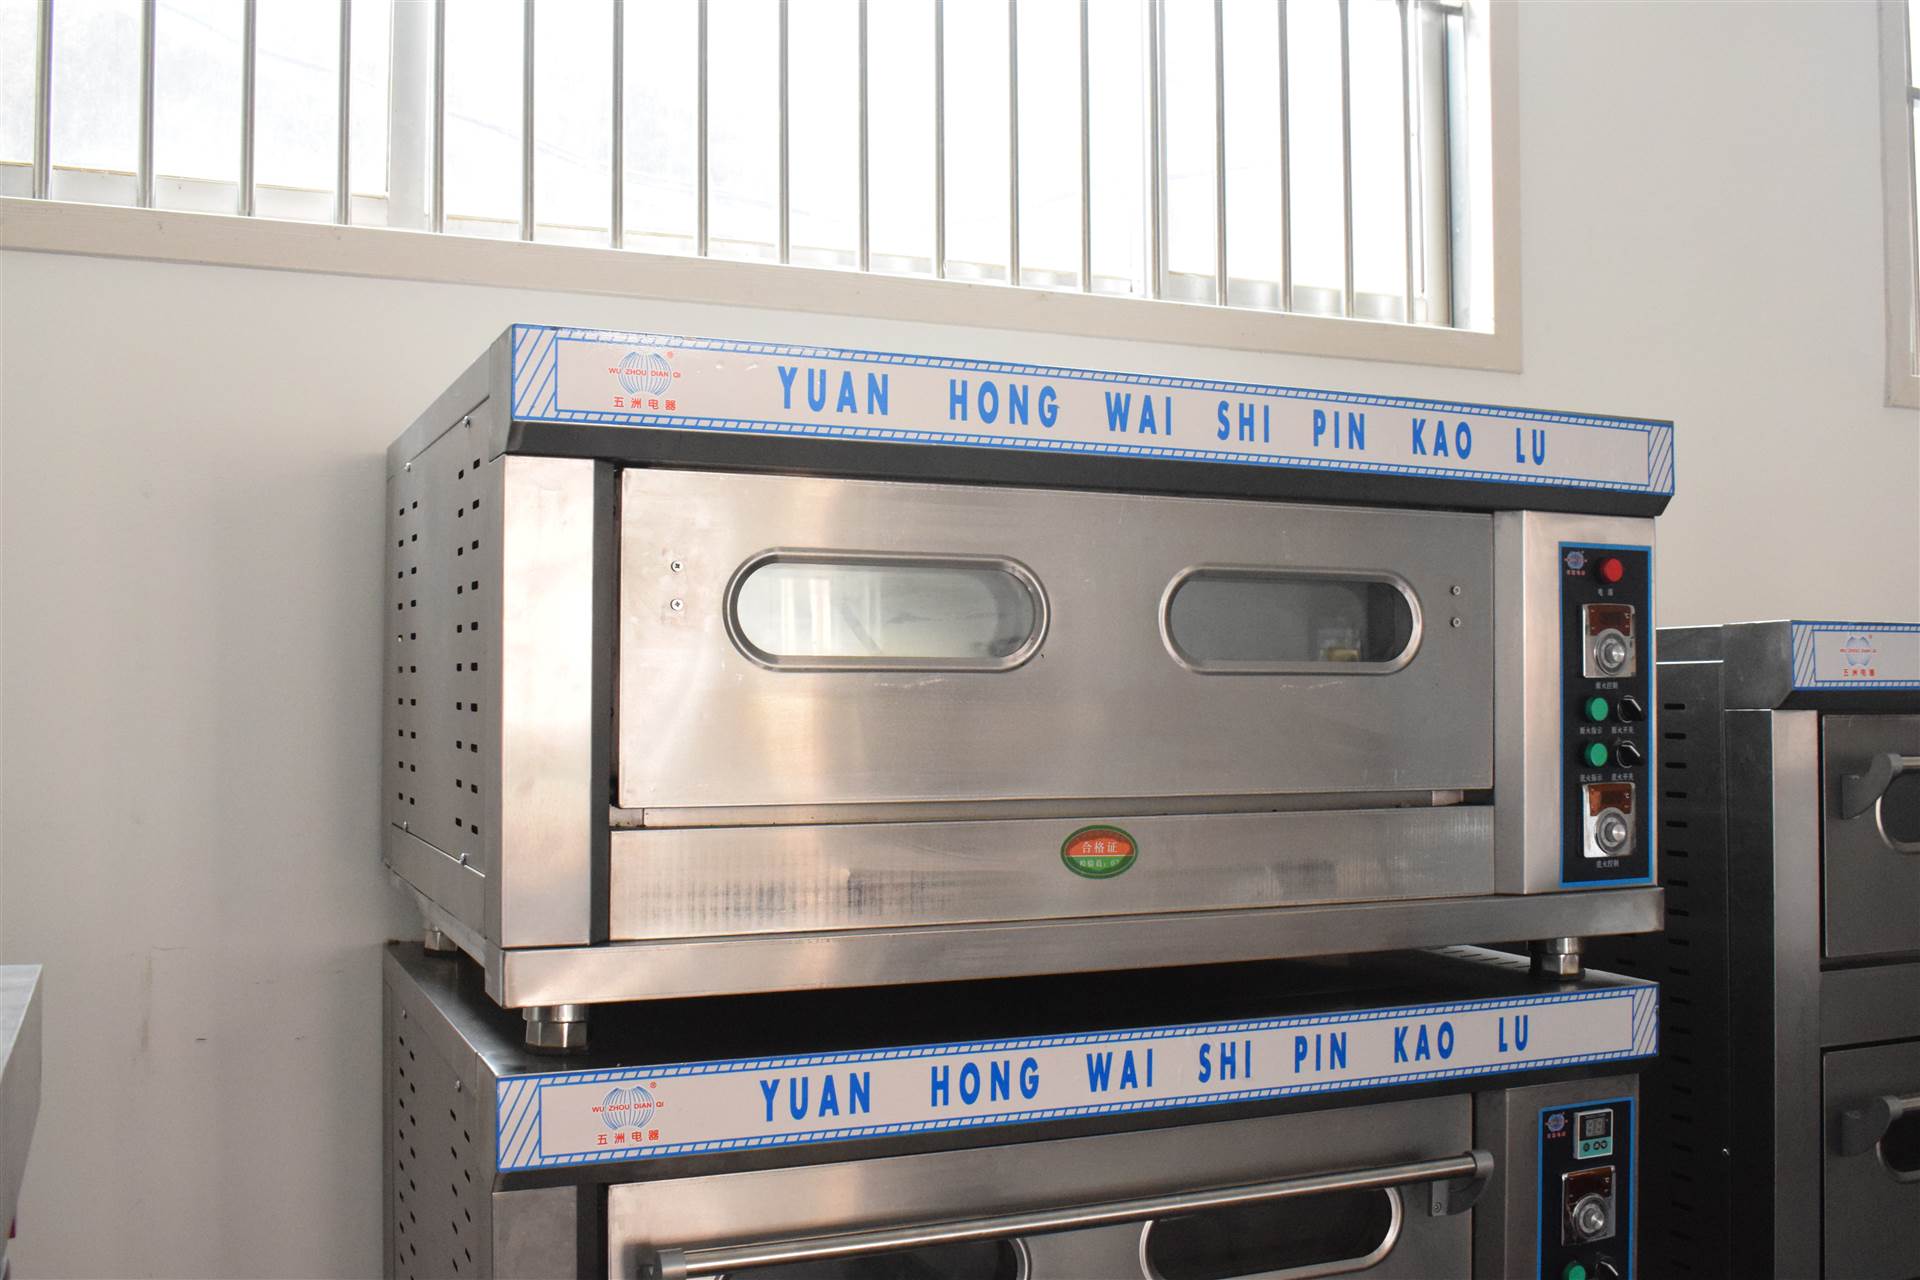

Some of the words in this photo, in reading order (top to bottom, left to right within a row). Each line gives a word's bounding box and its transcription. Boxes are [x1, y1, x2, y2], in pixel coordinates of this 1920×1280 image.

[614, 396, 676, 411] 五洲电器
[780, 367, 888, 415] YUAN
[950, 380, 1058, 427] HONG
[1106, 392, 1172, 434] WAI
[1218, 402, 1270, 442] SHI
[1314, 410, 1364, 449] PIN
[1412, 419, 1472, 459] KAO
[1517, 430, 1545, 464] LU
[1082, 841, 1118, 853] 合格证
[760, 1072, 870, 1121] YUAN
[931, 1058, 1039, 1107] HONG
[1088, 1049, 1153, 1092] WAI
[1200, 1040, 1251, 1082] SHI
[1296, 1033, 1346, 1072] PIN
[1395, 1023, 1454, 1062] KAO
[1500, 1017, 1528, 1052] LU
[597, 1129, 659, 1145] 五洲电器
